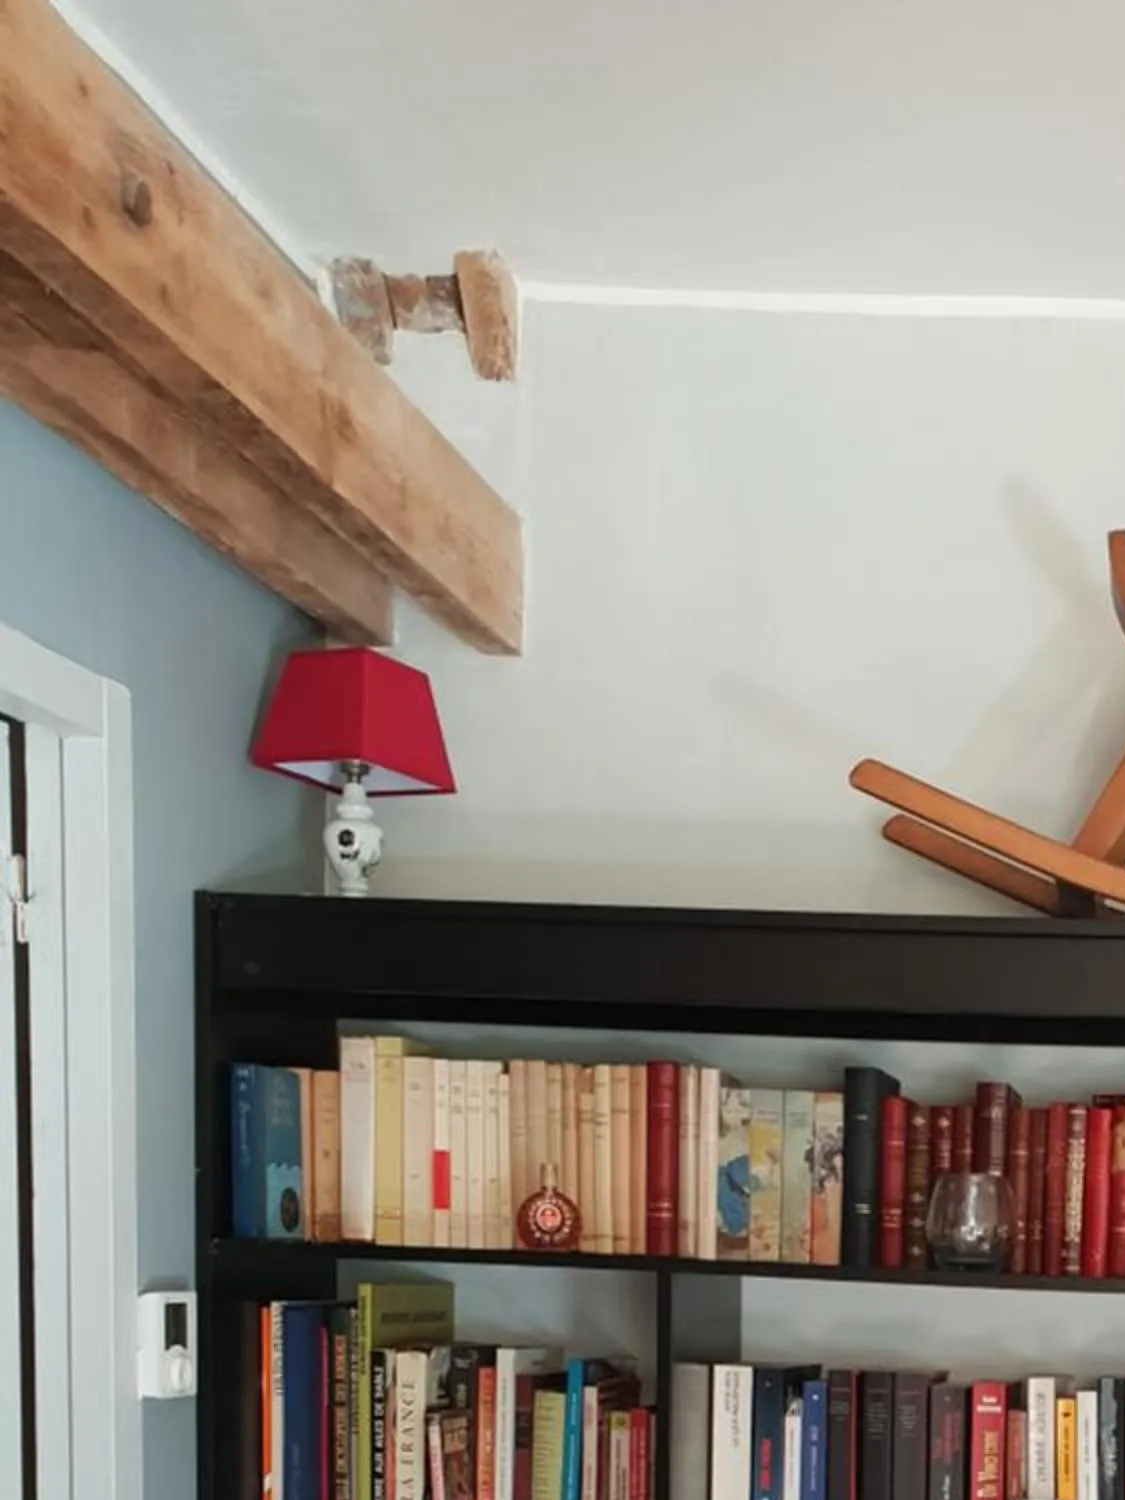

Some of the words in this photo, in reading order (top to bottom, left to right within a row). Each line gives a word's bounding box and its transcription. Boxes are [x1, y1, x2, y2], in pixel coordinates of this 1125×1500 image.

[373, 1367, 385, 1398] SABLE
[373, 1401, 385, 1416] DE
[373, 1419, 384, 1448] AILES
[401, 1382, 417, 1466] FRANCE
[373, 1451, 384, 1473] AUX
